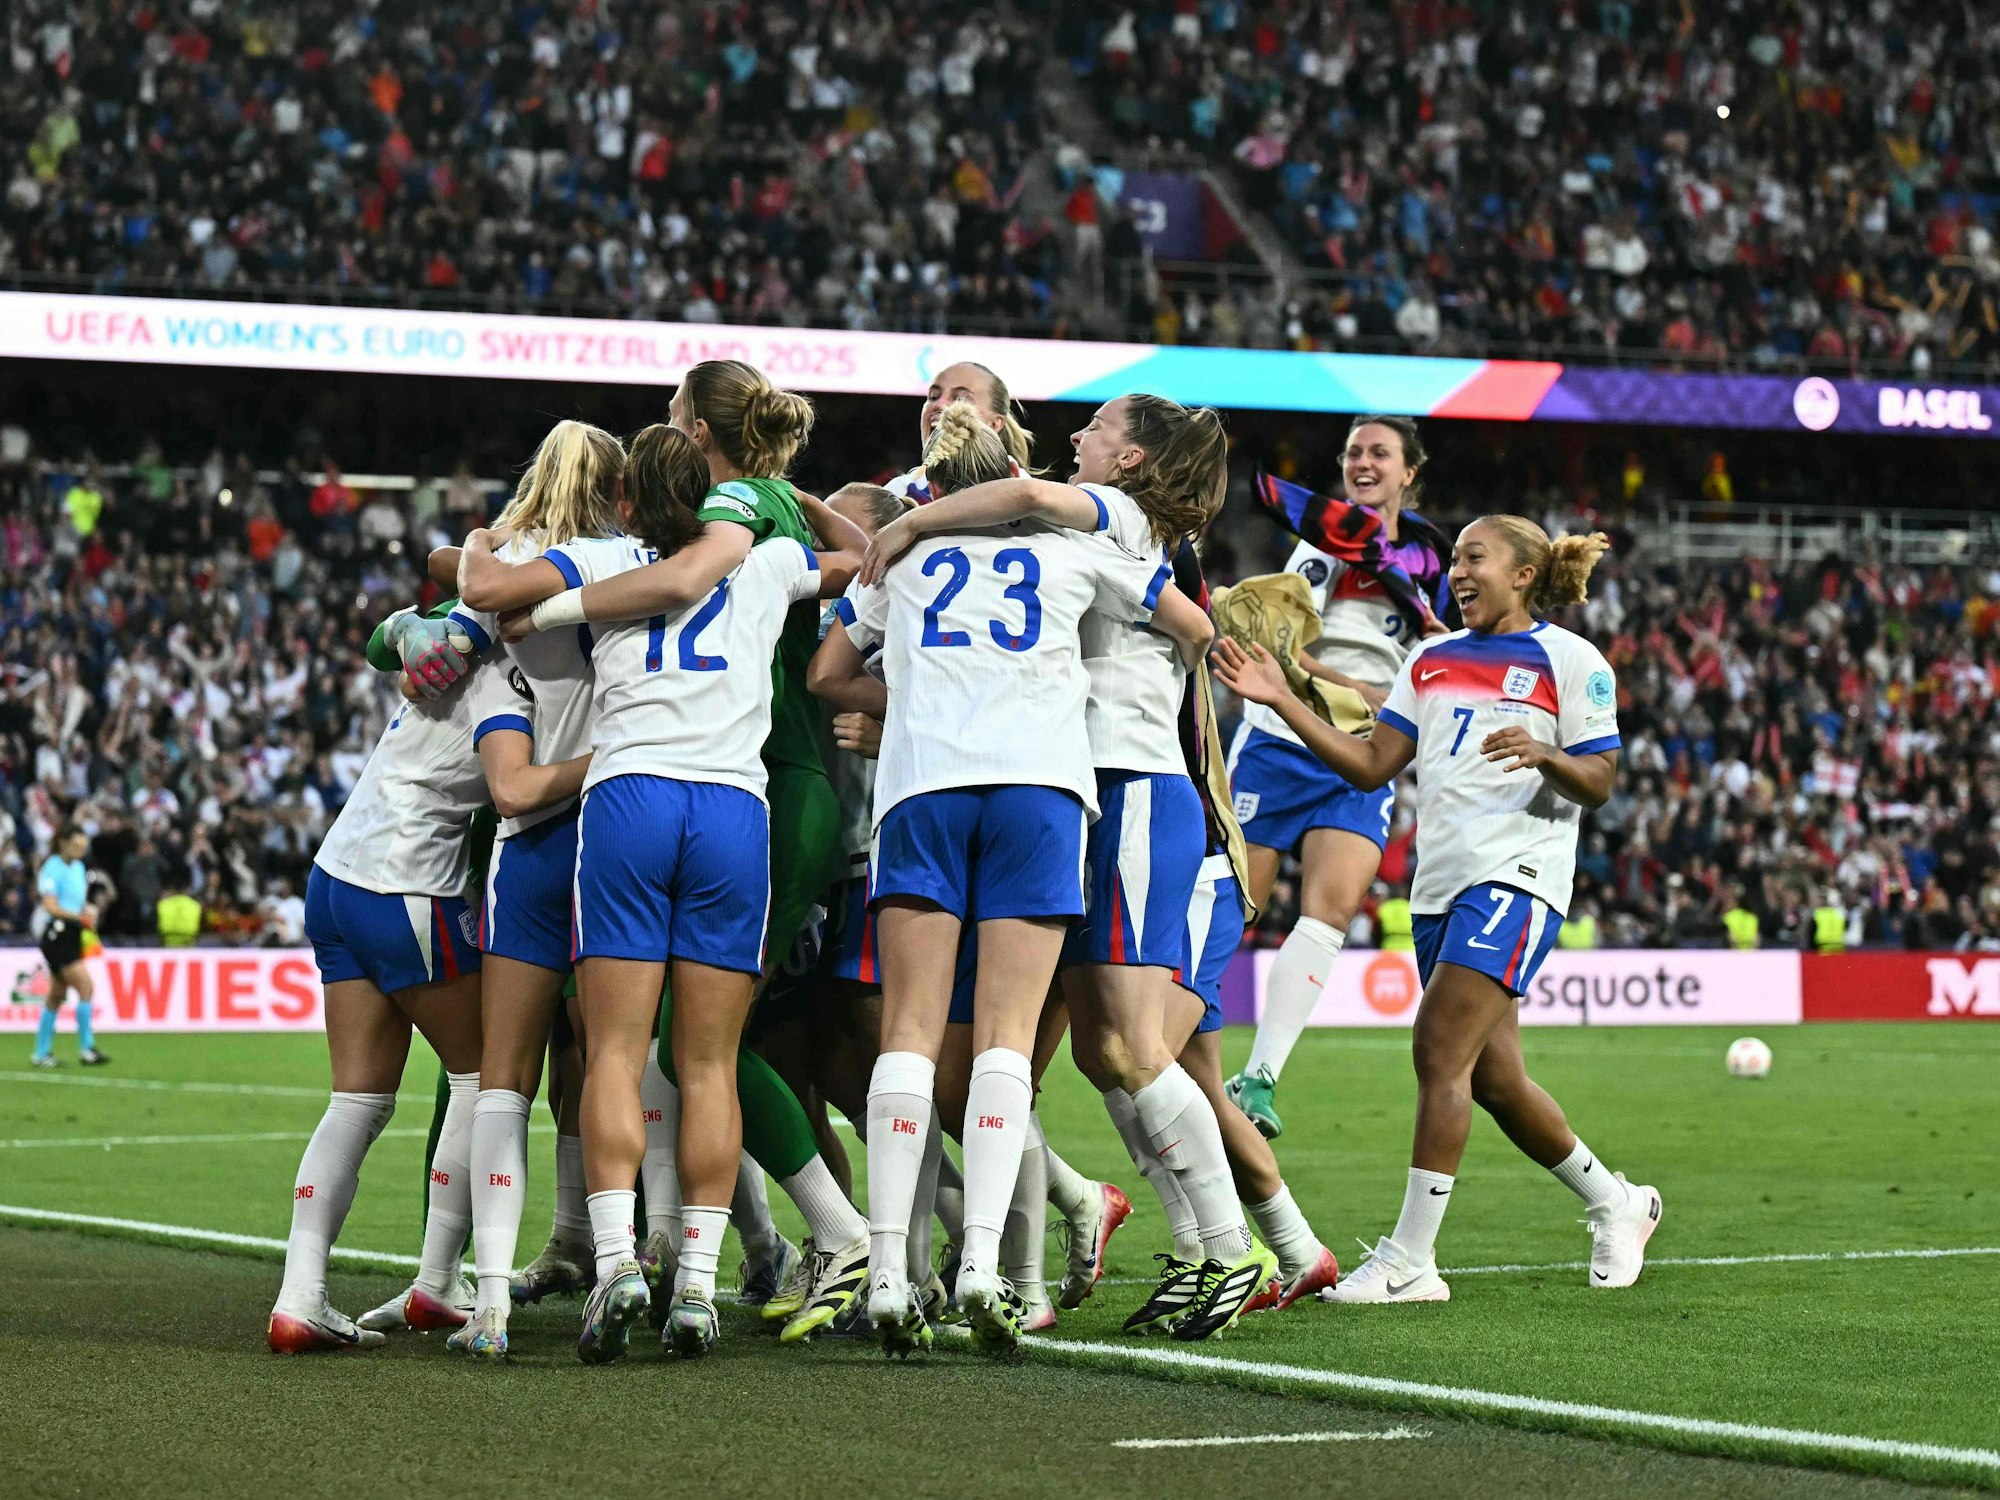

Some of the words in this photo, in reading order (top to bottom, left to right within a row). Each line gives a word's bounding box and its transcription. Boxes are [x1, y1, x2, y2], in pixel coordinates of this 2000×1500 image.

[45, 311, 154, 346] UEFA
[165, 317, 350, 356] WOMEN'S
[363, 326, 465, 362] EURO
[479, 329, 750, 368] SWITZERLAND
[767, 341, 857, 376] 2025
[1878, 387, 1992, 430] BASEL
[921, 546, 1042, 652] 23
[645, 577, 729, 673] 12
[1450, 707, 1474, 756] 7
[1482, 888, 1514, 936] 7
[106, 960, 317, 1022] WIES
[642, 1109, 662, 1123] ENG
[893, 1118, 917, 1135] ENG
[979, 1115, 1004, 1130] ENG
[489, 1173, 511, 1187] ENG
[684, 1226, 700, 1239] ENG
